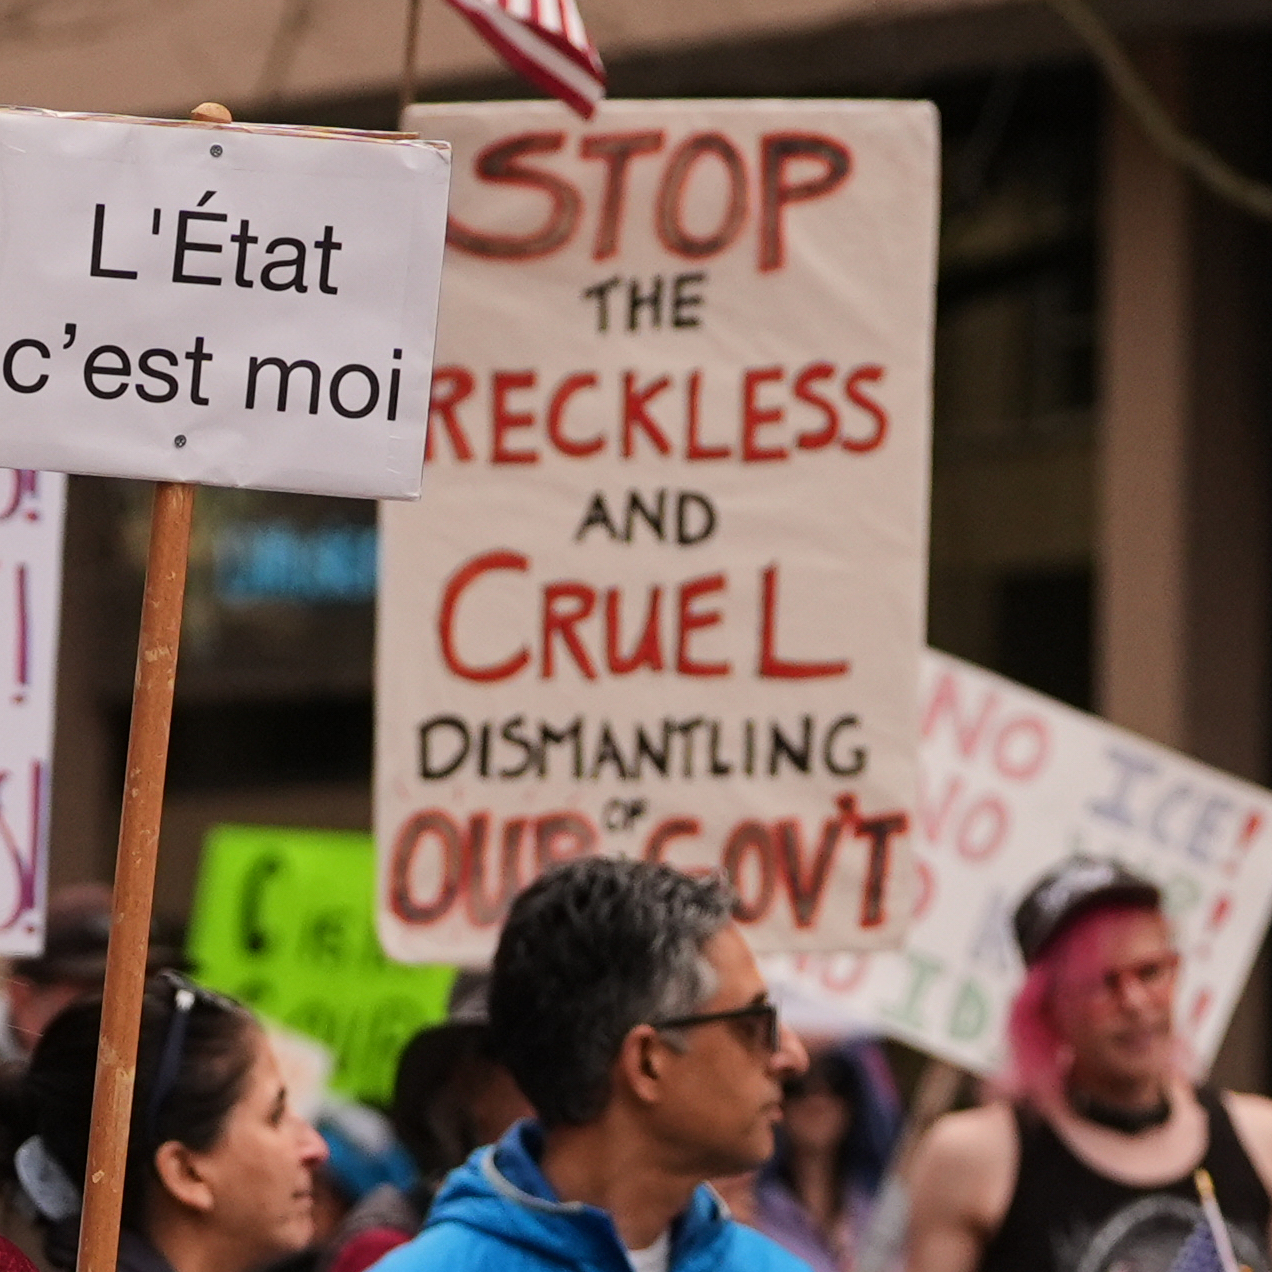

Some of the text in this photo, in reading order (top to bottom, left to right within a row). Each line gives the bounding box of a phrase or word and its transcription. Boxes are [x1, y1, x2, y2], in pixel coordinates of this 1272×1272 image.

[89, 190, 343, 295] L'État
[447, 127, 852, 273] STOP
[581, 271, 709, 333] THE
[244, 349, 402, 421] moi
[425, 362, 889, 465] RECKLESS
[574, 488, 718, 546] AND
[438, 549, 849, 684] CRUEL
[418, 714, 866, 781] DISMANTLING
[922, 672, 1262, 876] NO ICE!
